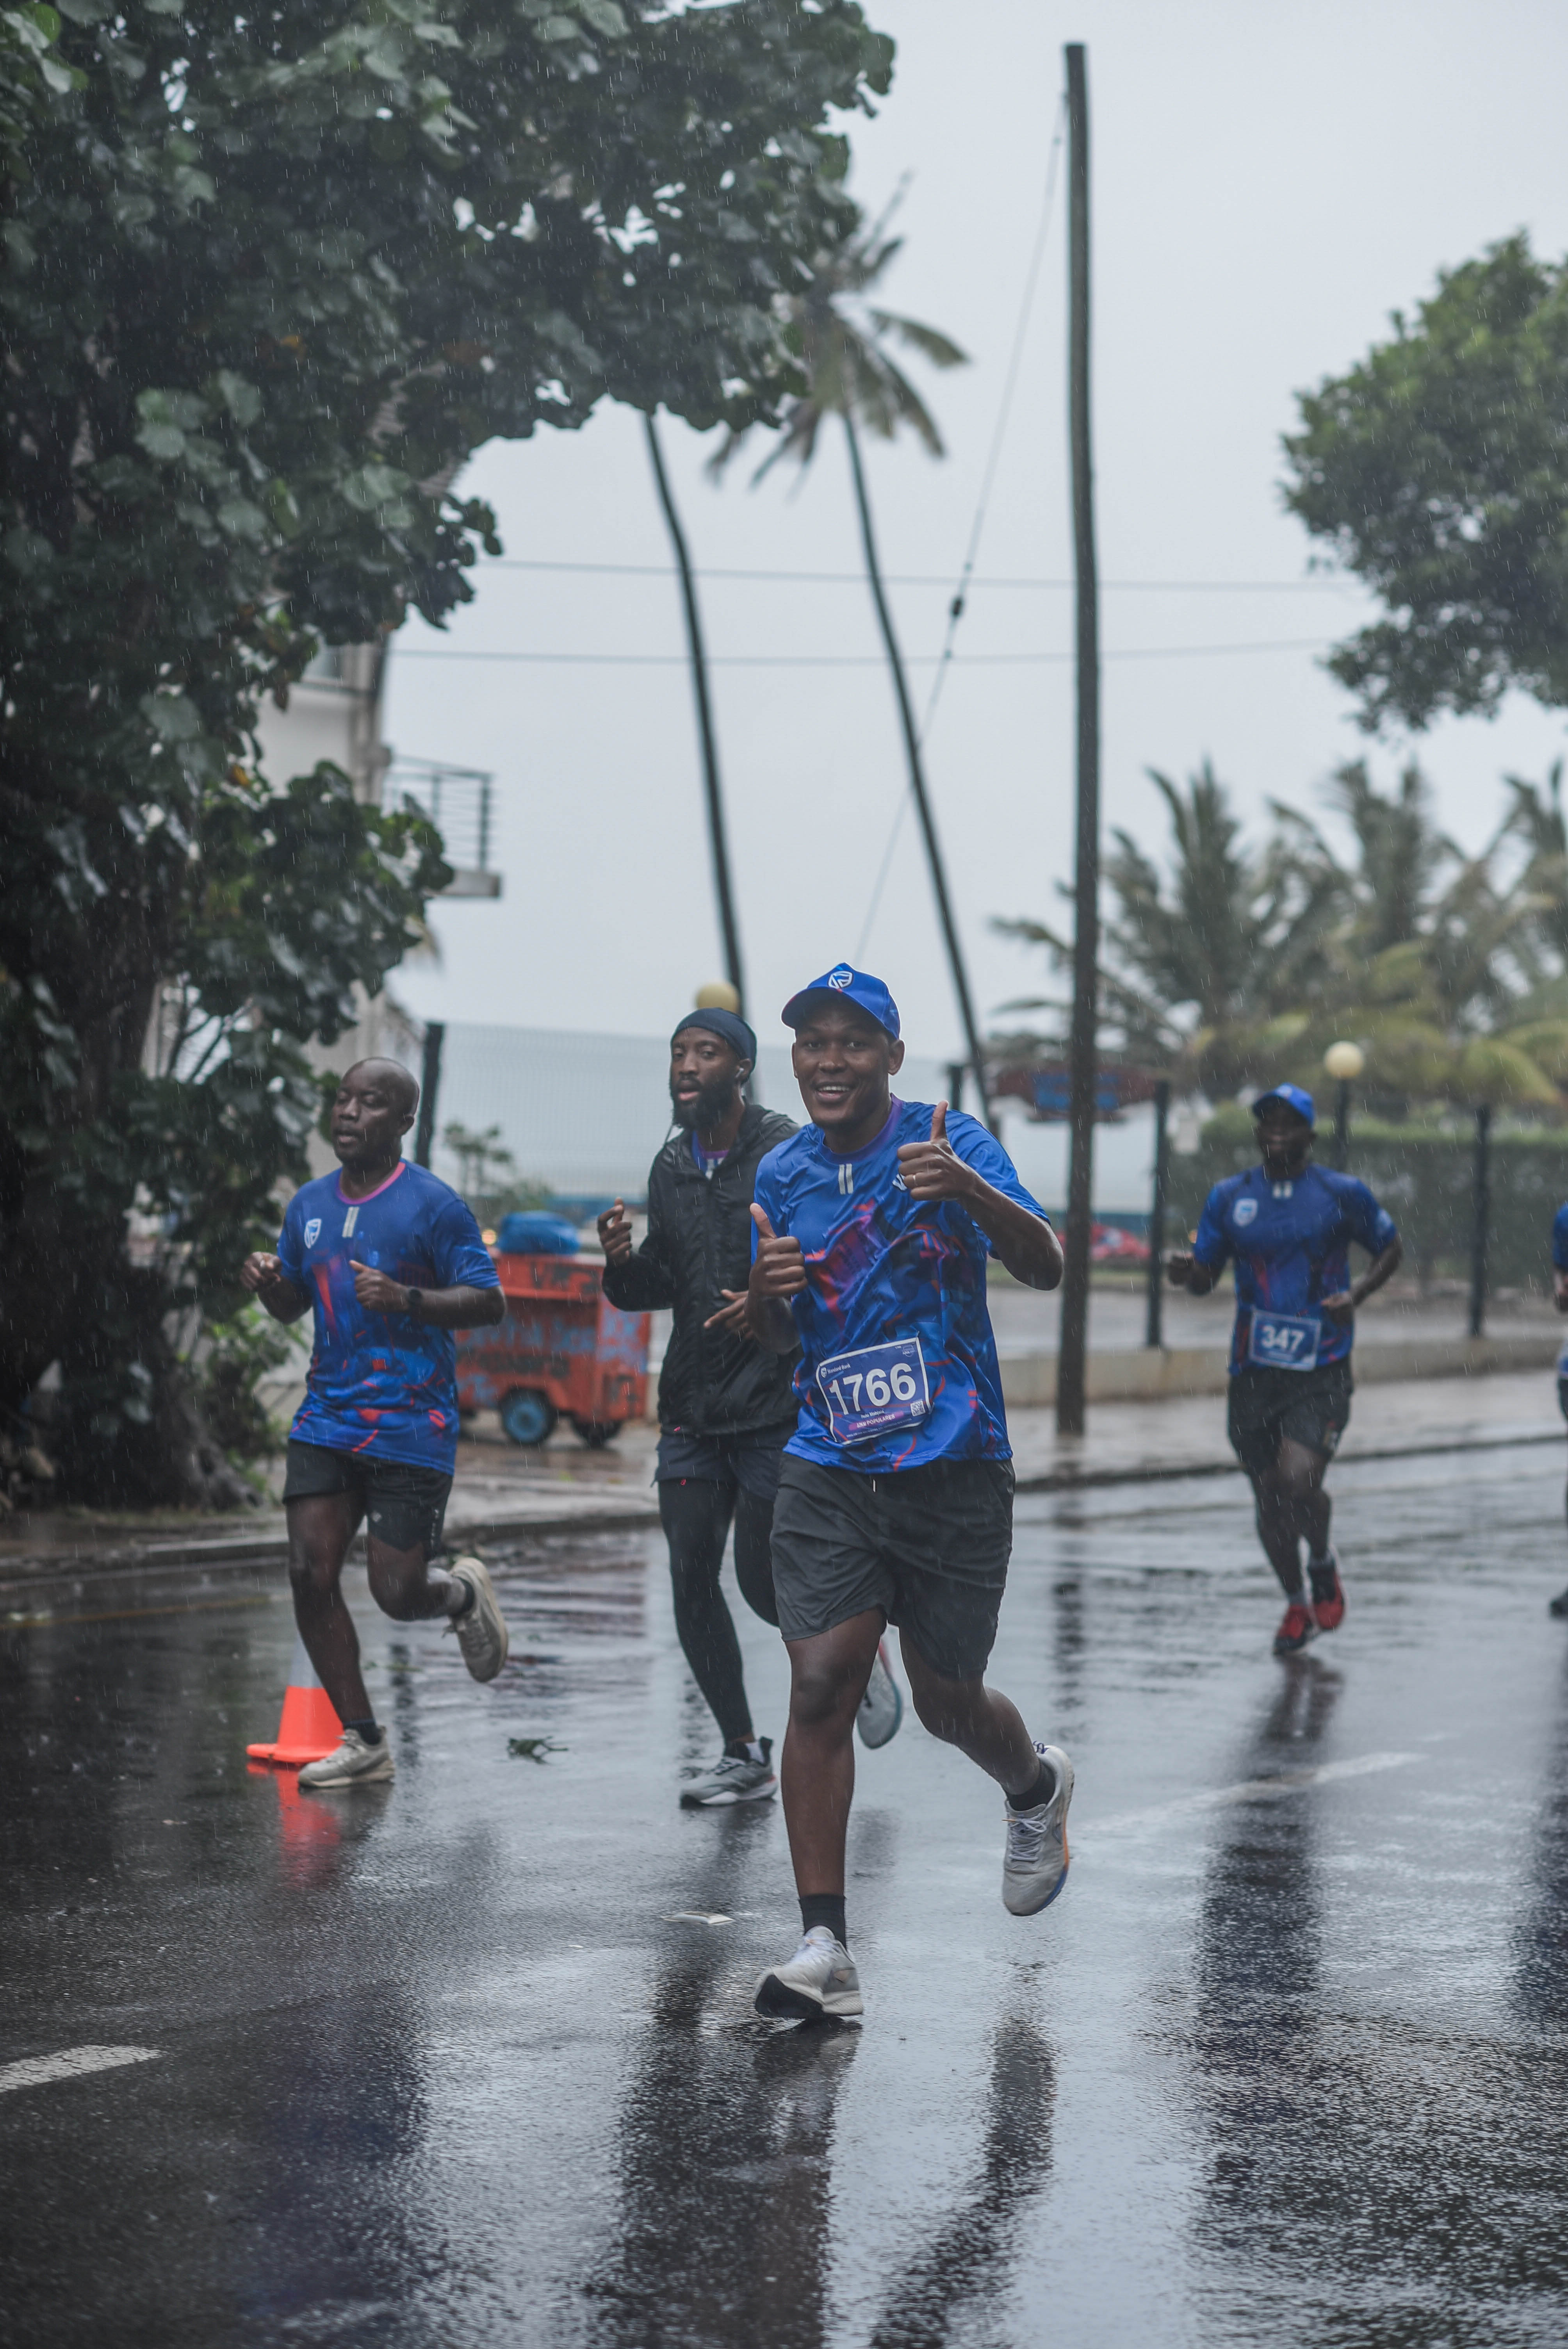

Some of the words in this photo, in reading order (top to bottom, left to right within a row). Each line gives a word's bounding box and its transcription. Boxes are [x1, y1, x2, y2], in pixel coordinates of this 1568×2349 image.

[1261, 1325, 1305, 1352] 347
[827, 1365, 841, 1374] Standard
[829, 1363, 916, 1415] 1766
[866, 1413, 895, 1426] POPULARES
